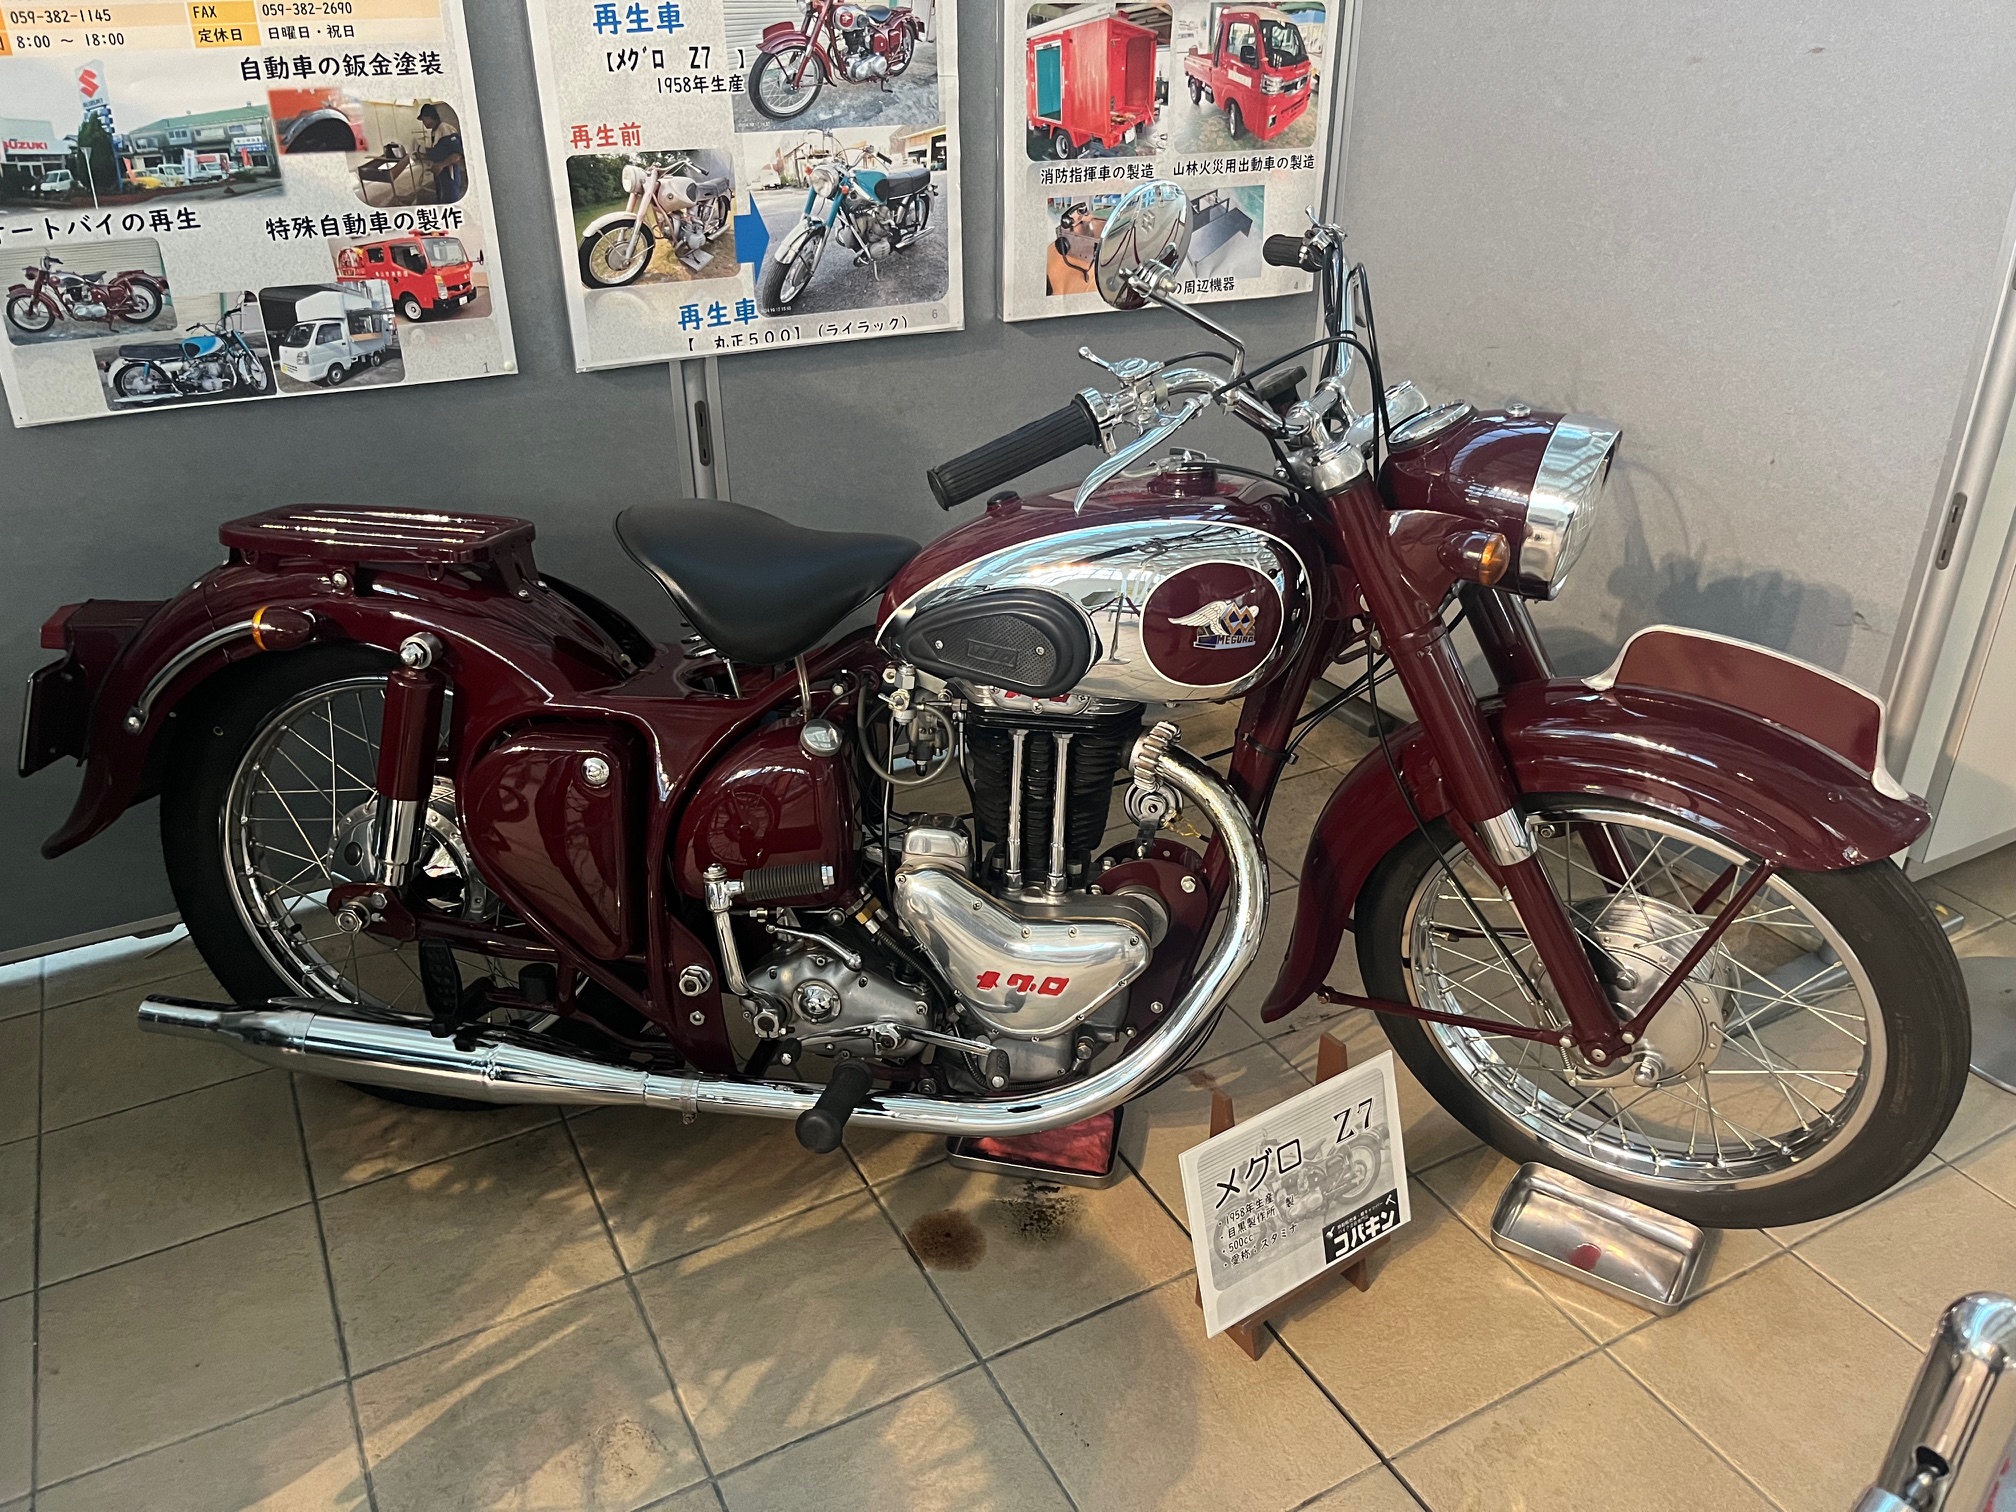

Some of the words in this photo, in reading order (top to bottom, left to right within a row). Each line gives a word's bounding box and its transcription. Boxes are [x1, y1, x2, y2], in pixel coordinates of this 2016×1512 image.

[10, 9, 111, 25] 059-382-1145
[193, 5, 217, 19] FAX
[262, 2, 353, 17] 059-382-2690
[593, 1, 684, 35] 再生車
[16, 35, 51, 48] 8:00
[85, 32, 125, 47] 18:00
[198, 28, 243, 43] 定休日
[268, 24, 355, 41] 日曜日・祝日
[240, 51, 444, 81] 自動車の鈑金塗装
[688, 46, 711, 69] Z7
[657, 74, 745, 94] 1958年生産
[569, 121, 642, 148] 再生前
[1040, 164, 1154, 185] 消防指揮車の製造
[1173, 154, 1316, 176] 山林火災用出動車の製造
[0, 206, 202, 245] ートバイの再生
[265, 206, 464, 242] 特殊自動車の製作
[677, 297, 758, 331] 再生車
[931, 309, 938, 320] 6
[482, 361, 491, 374] 1
[1217, 634, 1255, 645] MEGURO
[1215, 1138, 1303, 1210] メグロ
[1333, 1097, 1375, 1145] Z7
[1333, 1210, 1395, 1258] コバキン
